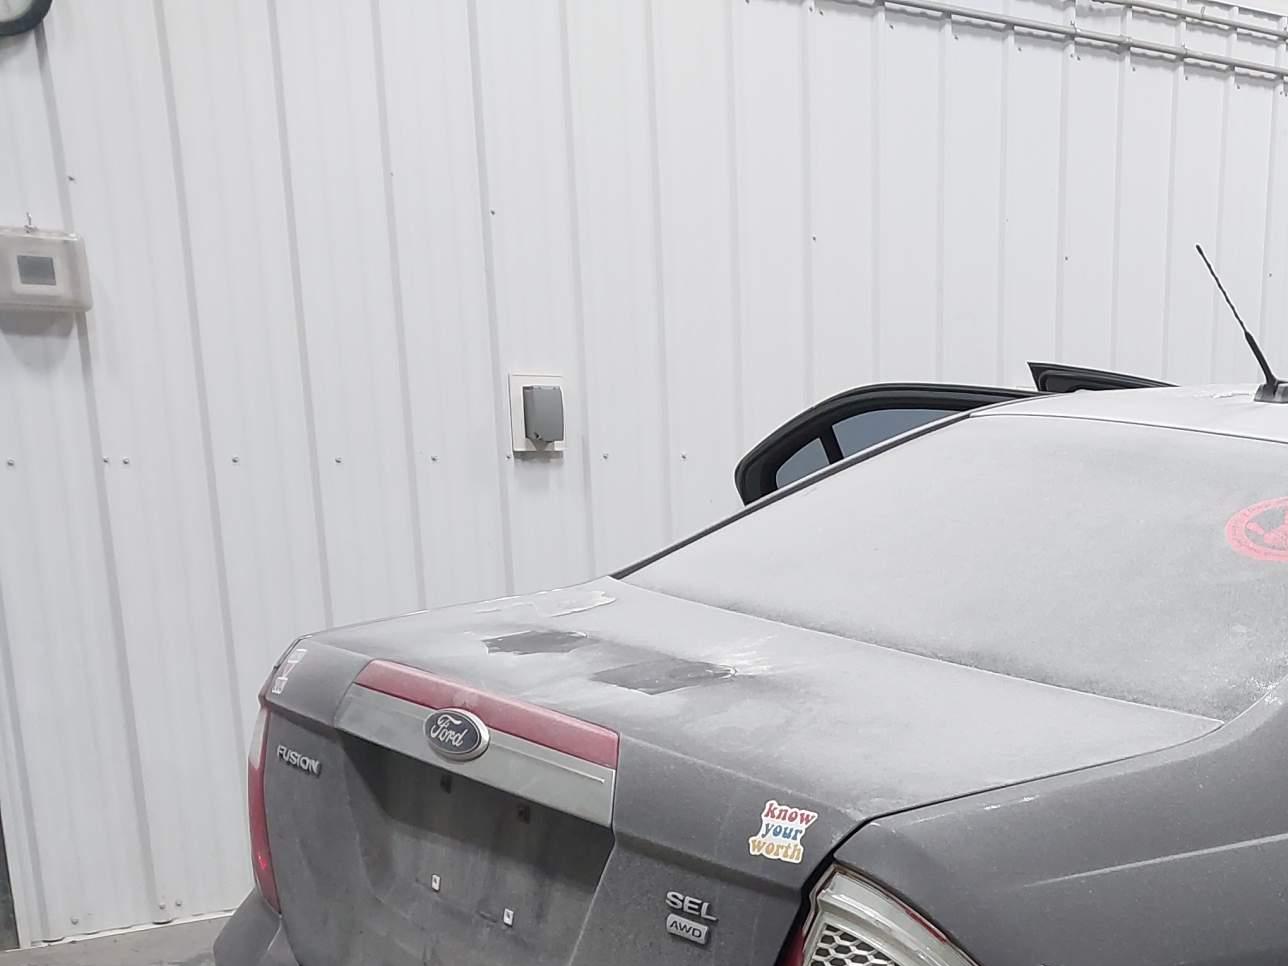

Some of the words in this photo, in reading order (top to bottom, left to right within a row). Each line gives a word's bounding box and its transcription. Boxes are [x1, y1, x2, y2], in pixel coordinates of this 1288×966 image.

[430, 714, 469, 747] Ford
[276, 744, 321, 775] FUSION
[764, 802, 816, 825] know
[761, 822, 802, 841] your
[750, 838, 802, 862] worth
[665, 890, 718, 921] SEL
[669, 919, 703, 939] AWD
